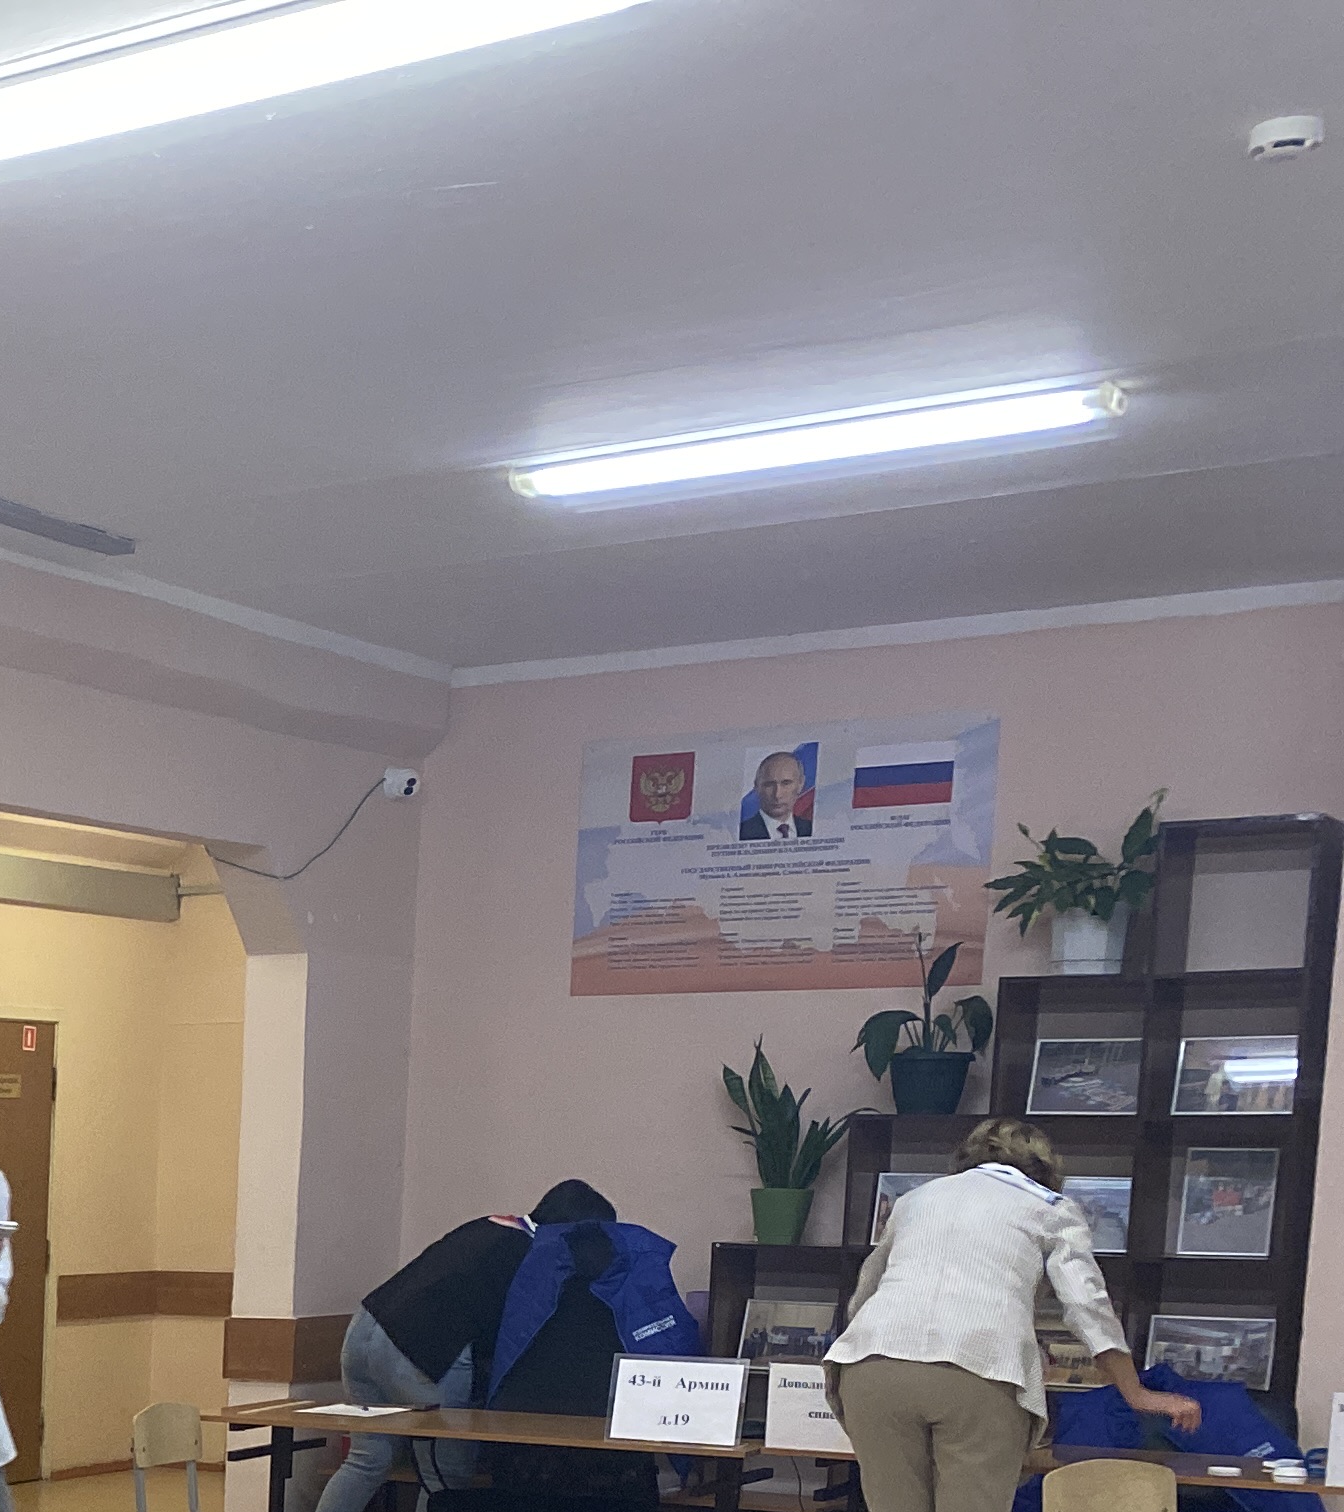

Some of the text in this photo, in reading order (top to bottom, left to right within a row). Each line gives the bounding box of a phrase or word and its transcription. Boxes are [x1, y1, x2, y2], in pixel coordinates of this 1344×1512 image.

[628, 1375, 730, 1393] 43-й Армии
[778, 1378, 826, 1390] Дополн
[657, 1413, 690, 1426] д.19
